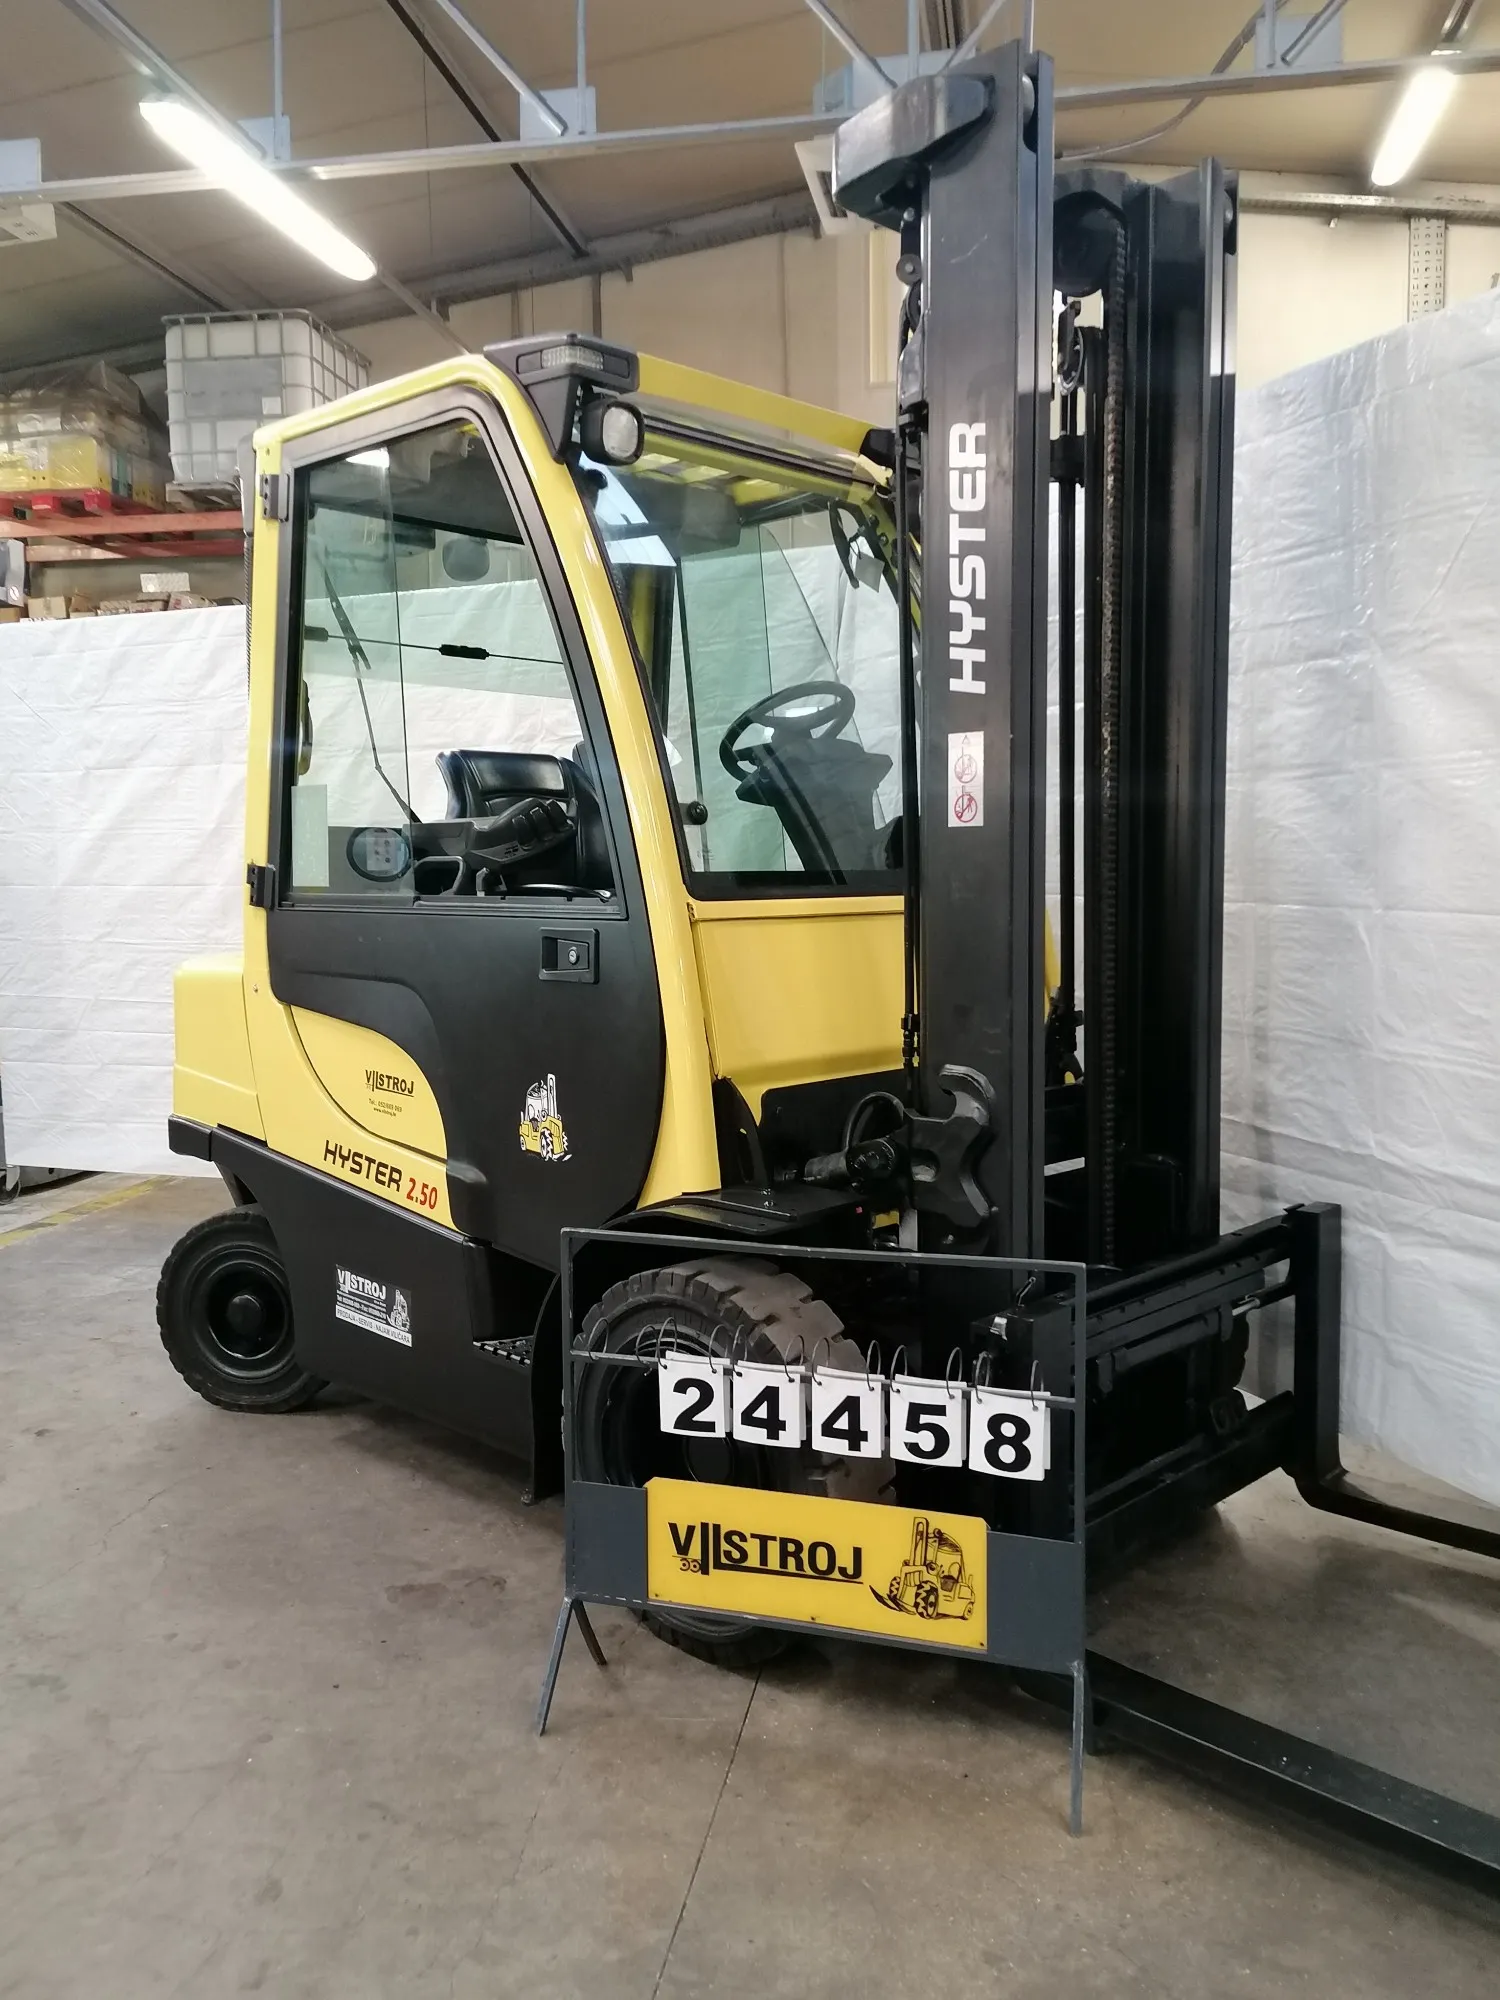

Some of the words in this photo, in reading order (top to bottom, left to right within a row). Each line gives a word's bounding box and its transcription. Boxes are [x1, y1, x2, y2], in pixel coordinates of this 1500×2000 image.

[949, 421, 986, 694] HYSTER
[323, 1140, 402, 1192] HYSTER
[406, 1177, 438, 1210] 2.50
[668, 1521, 863, 1584] VILSTROJ
